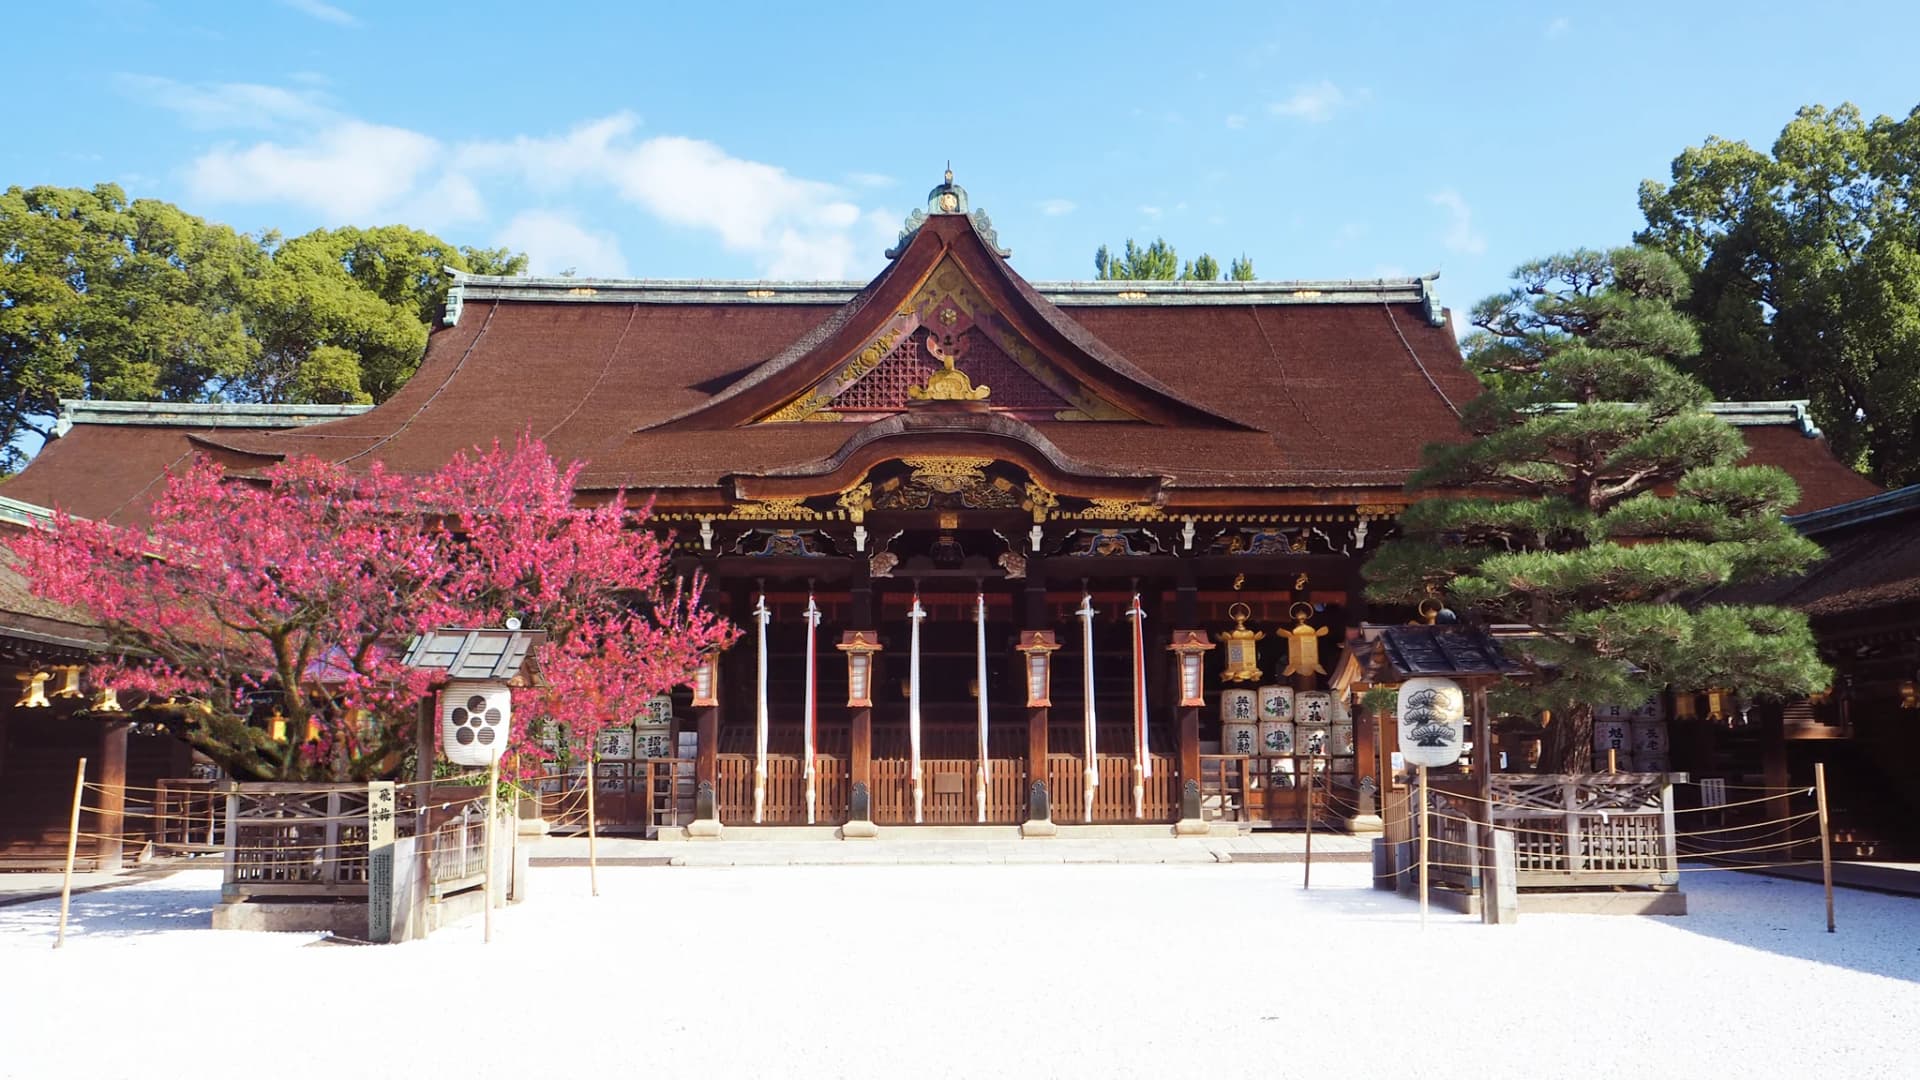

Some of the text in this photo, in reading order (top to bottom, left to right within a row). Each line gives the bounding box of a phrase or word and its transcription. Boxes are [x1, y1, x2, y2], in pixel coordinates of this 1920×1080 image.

[1236, 696, 1249, 719] 英勲
[1308, 701, 1321, 722] 千福
[1237, 731, 1250, 754] 英勲
[1308, 734, 1321, 755] 千福
[1608, 728, 1623, 749] 旭日
